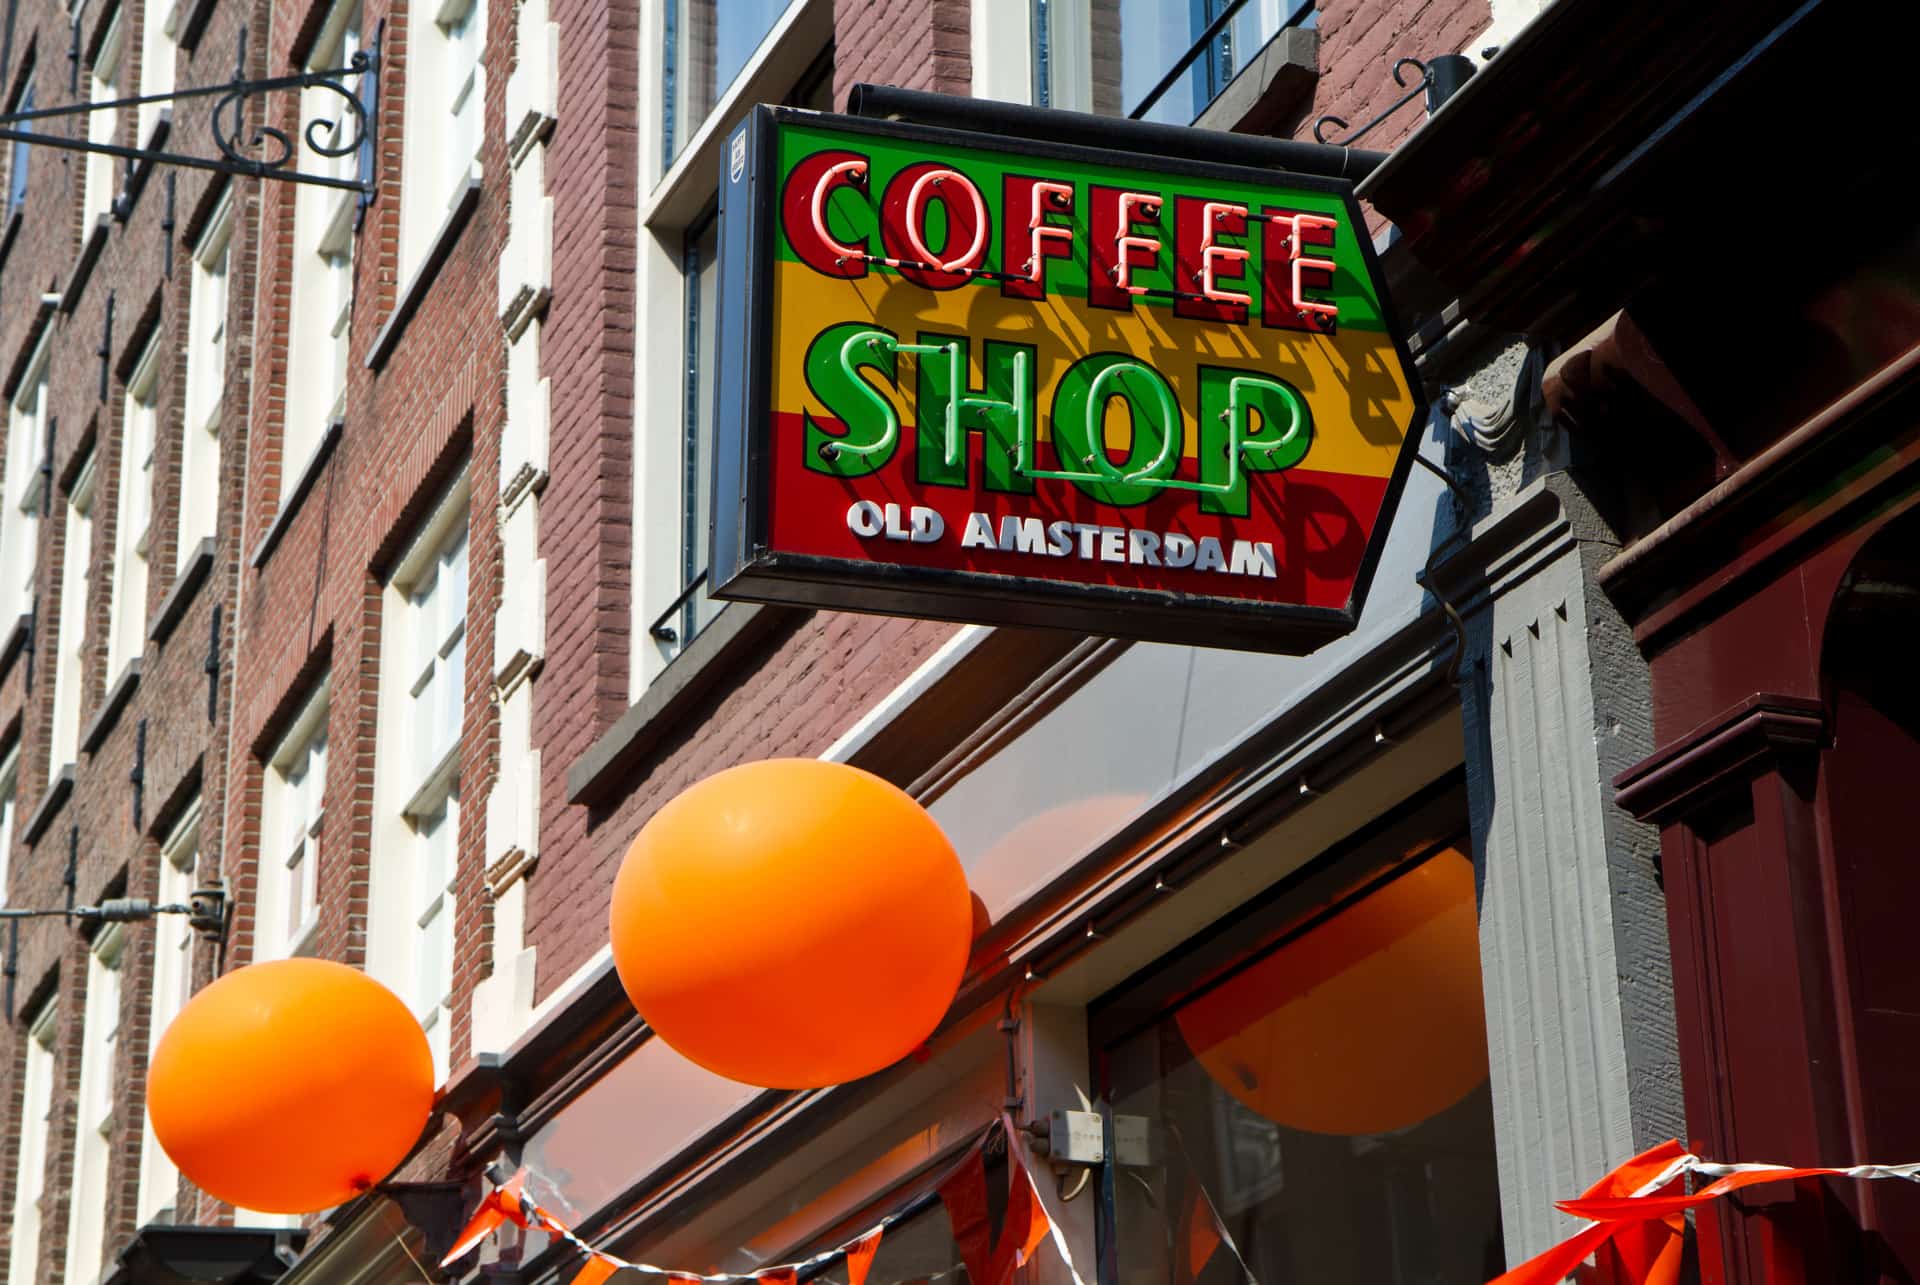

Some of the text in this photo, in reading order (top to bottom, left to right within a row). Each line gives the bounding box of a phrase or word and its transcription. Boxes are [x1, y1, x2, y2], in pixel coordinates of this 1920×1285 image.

[781, 149, 1338, 334] COFFEE
[803, 321, 1314, 518] SHOP
[846, 500, 1278, 578] OLD AMSTERDAM
